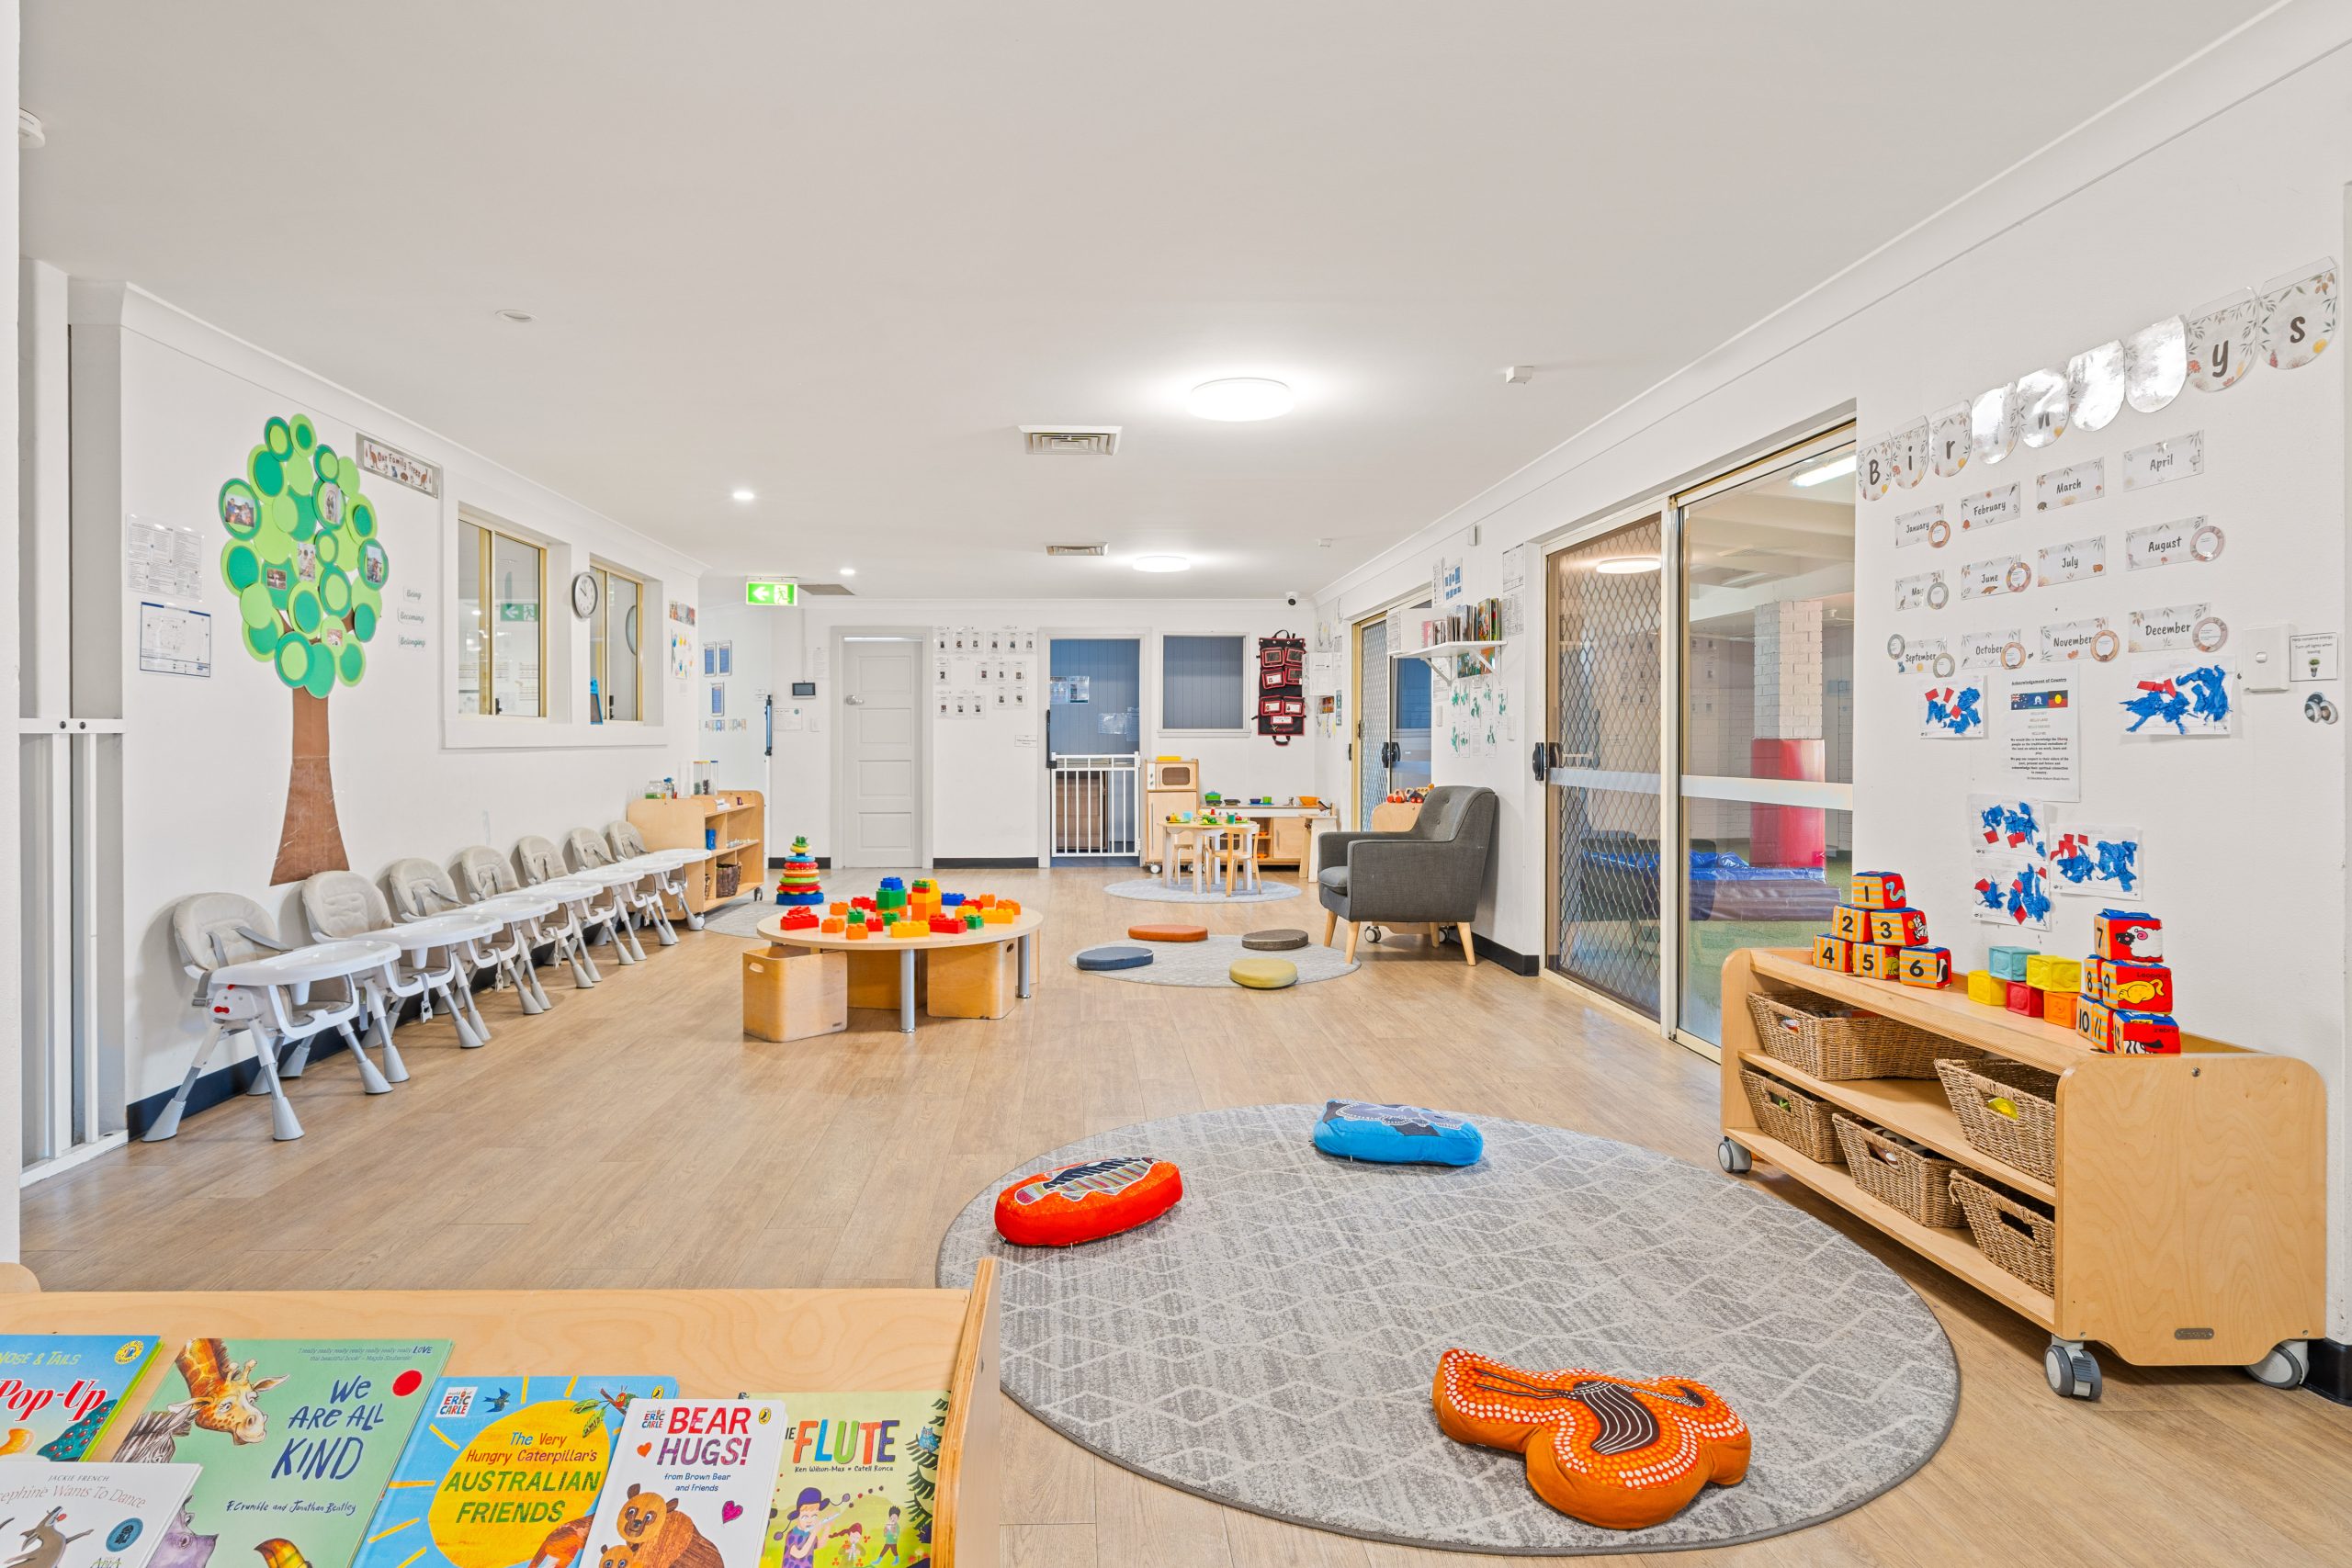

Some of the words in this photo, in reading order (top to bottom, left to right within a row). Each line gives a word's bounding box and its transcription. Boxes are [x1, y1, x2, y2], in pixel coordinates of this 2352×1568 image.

[2150, 454, 2174, 471] April
[2056, 480, 2082, 493] March
[1973, 502, 2007, 516] February
[1905, 522, 1929, 534] January
[2148, 536, 2182, 553] August
[2062, 558, 2078, 570] July
[1981, 574, 1998, 584] June
[2145, 623, 2191, 636] December
[1975, 644, 2003, 655] October
[2053, 636, 2092, 647] November
[1905, 651, 1936, 663] September
[1864, 886, 1870, 902] 1
[1842, 916, 1853, 933] 2
[1880, 921, 1893, 939] 3
[2097, 927, 2103, 948] 7
[1822, 946, 1835, 964] 4
[1862, 953, 1874, 971] 5
[1909, 960, 1924, 977] 6
[2087, 971, 2093, 992] 8
[2104, 973, 2110, 998] 9
[2079, 1009, 2090, 1032] 10
[2094, 1017, 2102, 1039] 11
[2114, 1024, 2120, 1050] 12
[413, 1346, 433, 1354] LOVE
[33, 1353, 45, 1366] &
[345, 1404, 384, 1431] ALL
[440, 1405, 468, 1415] CARLE
[667, 1406, 752, 1434] BEAR
[510, 1432, 533, 1445] The
[539, 1433, 567, 1448] Very
[793, 1419, 900, 1465] FLUTE
[271, 1437, 364, 1481] KIND
[466, 1450, 512, 1466] Hungry
[517, 1450, 597, 1465] Caterpillar's
[657, 1438, 752, 1466] HUGS!
[444, 1471, 602, 1492] AUSTRALIAN
[53, 1484, 89, 1498] Wants
[94, 1485, 108, 1499] To
[108, 1489, 146, 1508] Dance
[289, 1499, 323, 1513] Jonathan
[324, 1502, 356, 1516] Bentley
[456, 1499, 566, 1524] FRIENDS
